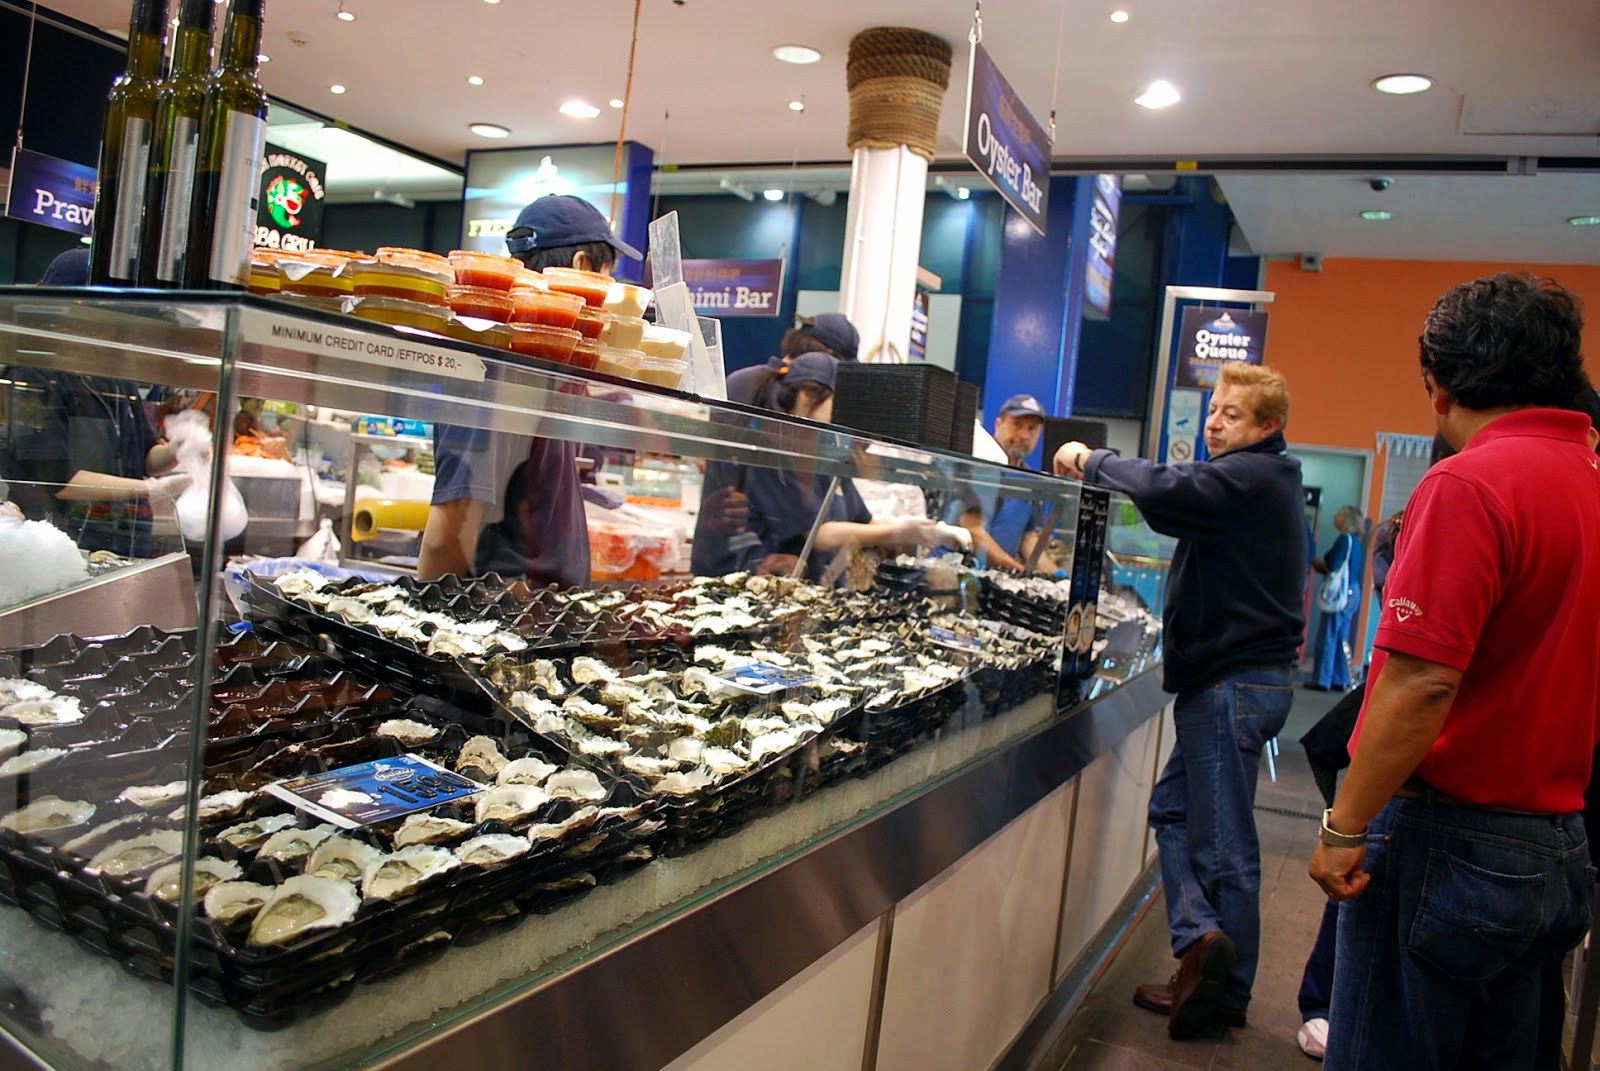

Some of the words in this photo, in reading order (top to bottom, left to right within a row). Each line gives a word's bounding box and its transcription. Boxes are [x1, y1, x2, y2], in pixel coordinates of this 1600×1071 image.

[977, 112, 1022, 192] Oyster
[1020, 162, 1043, 214] Bar
[33, 188, 95, 226] Praw
[733, 286, 773, 309] Bar
[271, 324, 323, 344] MINIMUM
[325, 335, 364, 353] CREDIT
[366, 342, 395, 358] CARD
[1194, 342, 1248, 360] Queue
[1195, 329, 1251, 347] Oyster
